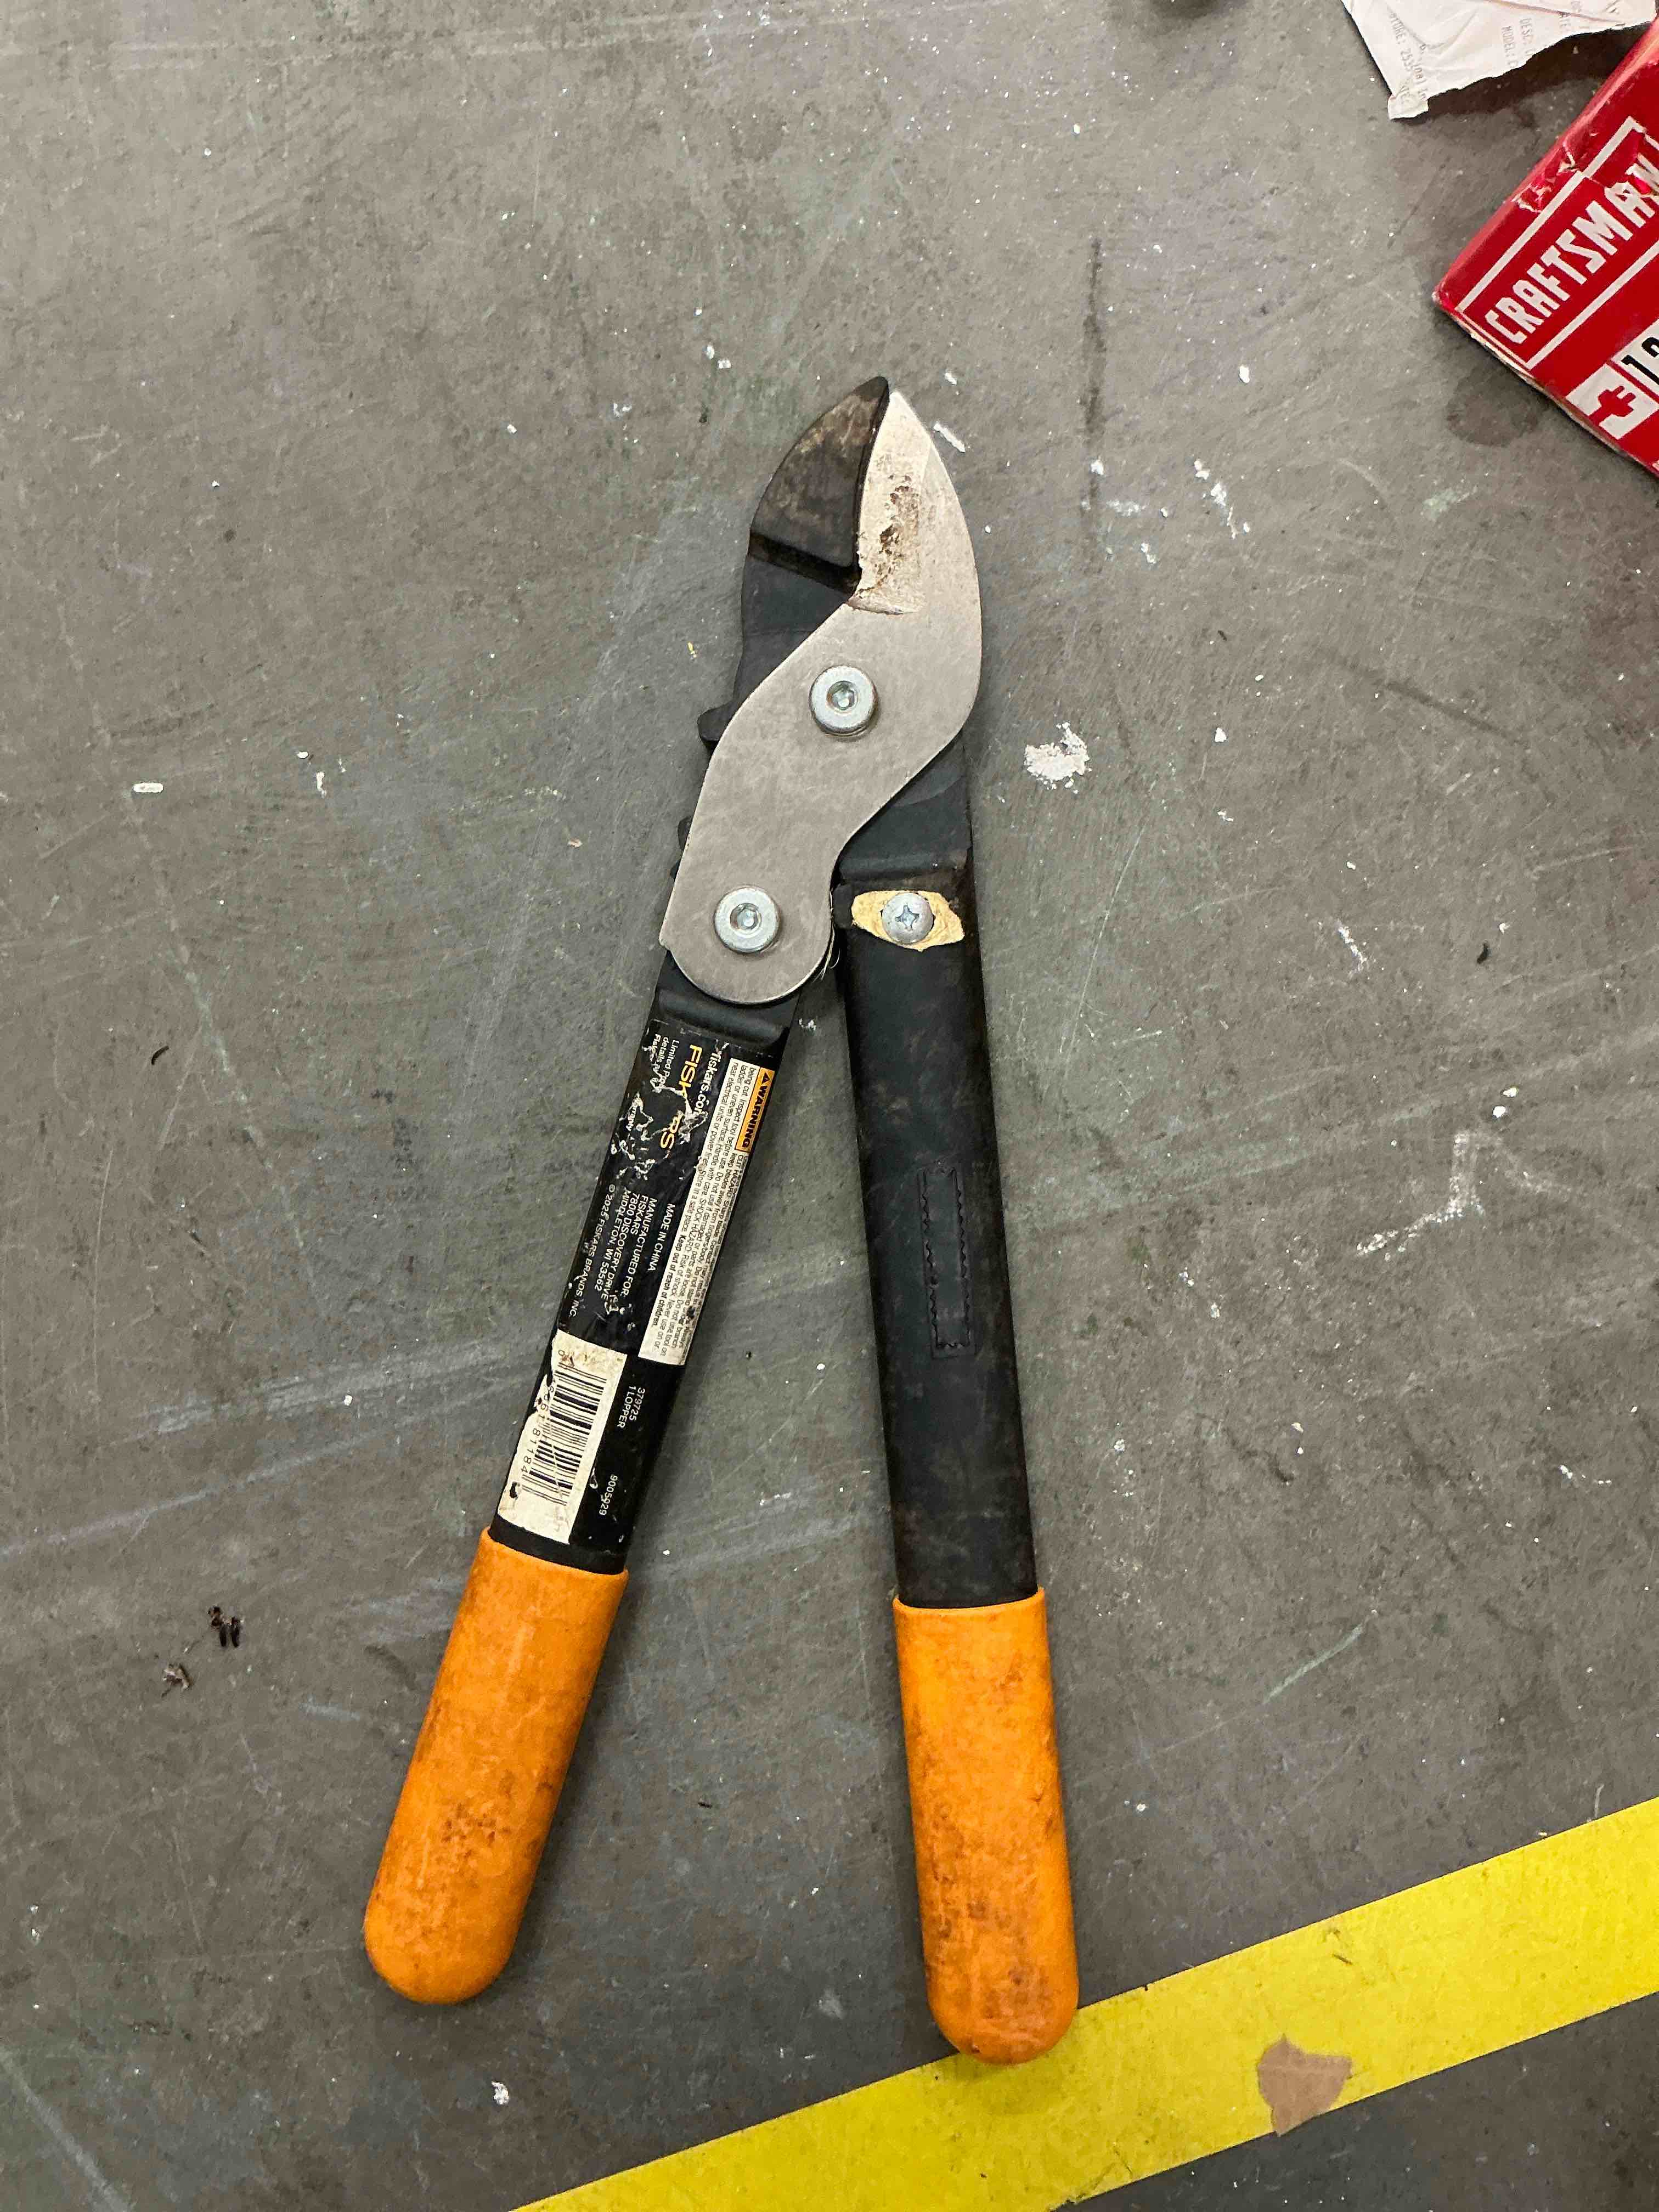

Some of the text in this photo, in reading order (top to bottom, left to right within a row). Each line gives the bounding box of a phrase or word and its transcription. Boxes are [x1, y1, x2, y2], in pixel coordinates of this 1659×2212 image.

[656, 1036, 670, 1064] details
[663, 1039, 680, 1070] Limited
[729, 1062, 740, 1076] near
[736, 1064, 748, 1085] ladder
[743, 1066, 757, 1086] being
[720, 1076, 735, 1105] electrical
[714, 1105, 726, 1122] units
[725, 1093, 738, 1117] uneven
[731, 1098, 747, 1123] Inspect
[741, 1084, 768, 1149] WARNING
[705, 1130, 718, 1151] power
[729, 1122, 739, 1136] tool
[710, 1143, 724, 1166] Handle
[722, 1135, 735, 1157] before
[706, 1166, 716, 1181] with
[629, 1194, 649, 1236] FISKARS
[686, 1201, 696, 1214] safe
[693, 1198, 707, 1222] SHOCK
[586, 1217, 606, 1258] FISKARS
[646, 1202, 676, 1273] MADE IN CHINA
[694, 1211, 711, 1242] damaged
[593, 1188, 632, 1292] MIDDLETON, WI 53562
[600, 1192, 640, 1301] 7800 DISCOVERY DRIVE
[618, 1197, 658, 1299] MANUFACTURED FOR:
[674, 1233, 687, 1252] Keep
[678, 1254, 690, 1269] Risk
[686, 1250, 698, 1267] parts
[662, 1271, 675, 1291] reach
[567, 1299, 580, 1319] INC.
[650, 1298, 667, 1329] children.
[663, 1298, 675, 1318] Never
[556, 1348, 566, 1357] 0
[616, 1390, 635, 1429] LOPPER
[628, 1386, 646, 1422] 379725
[519, 1427, 541, 1474] 81184
